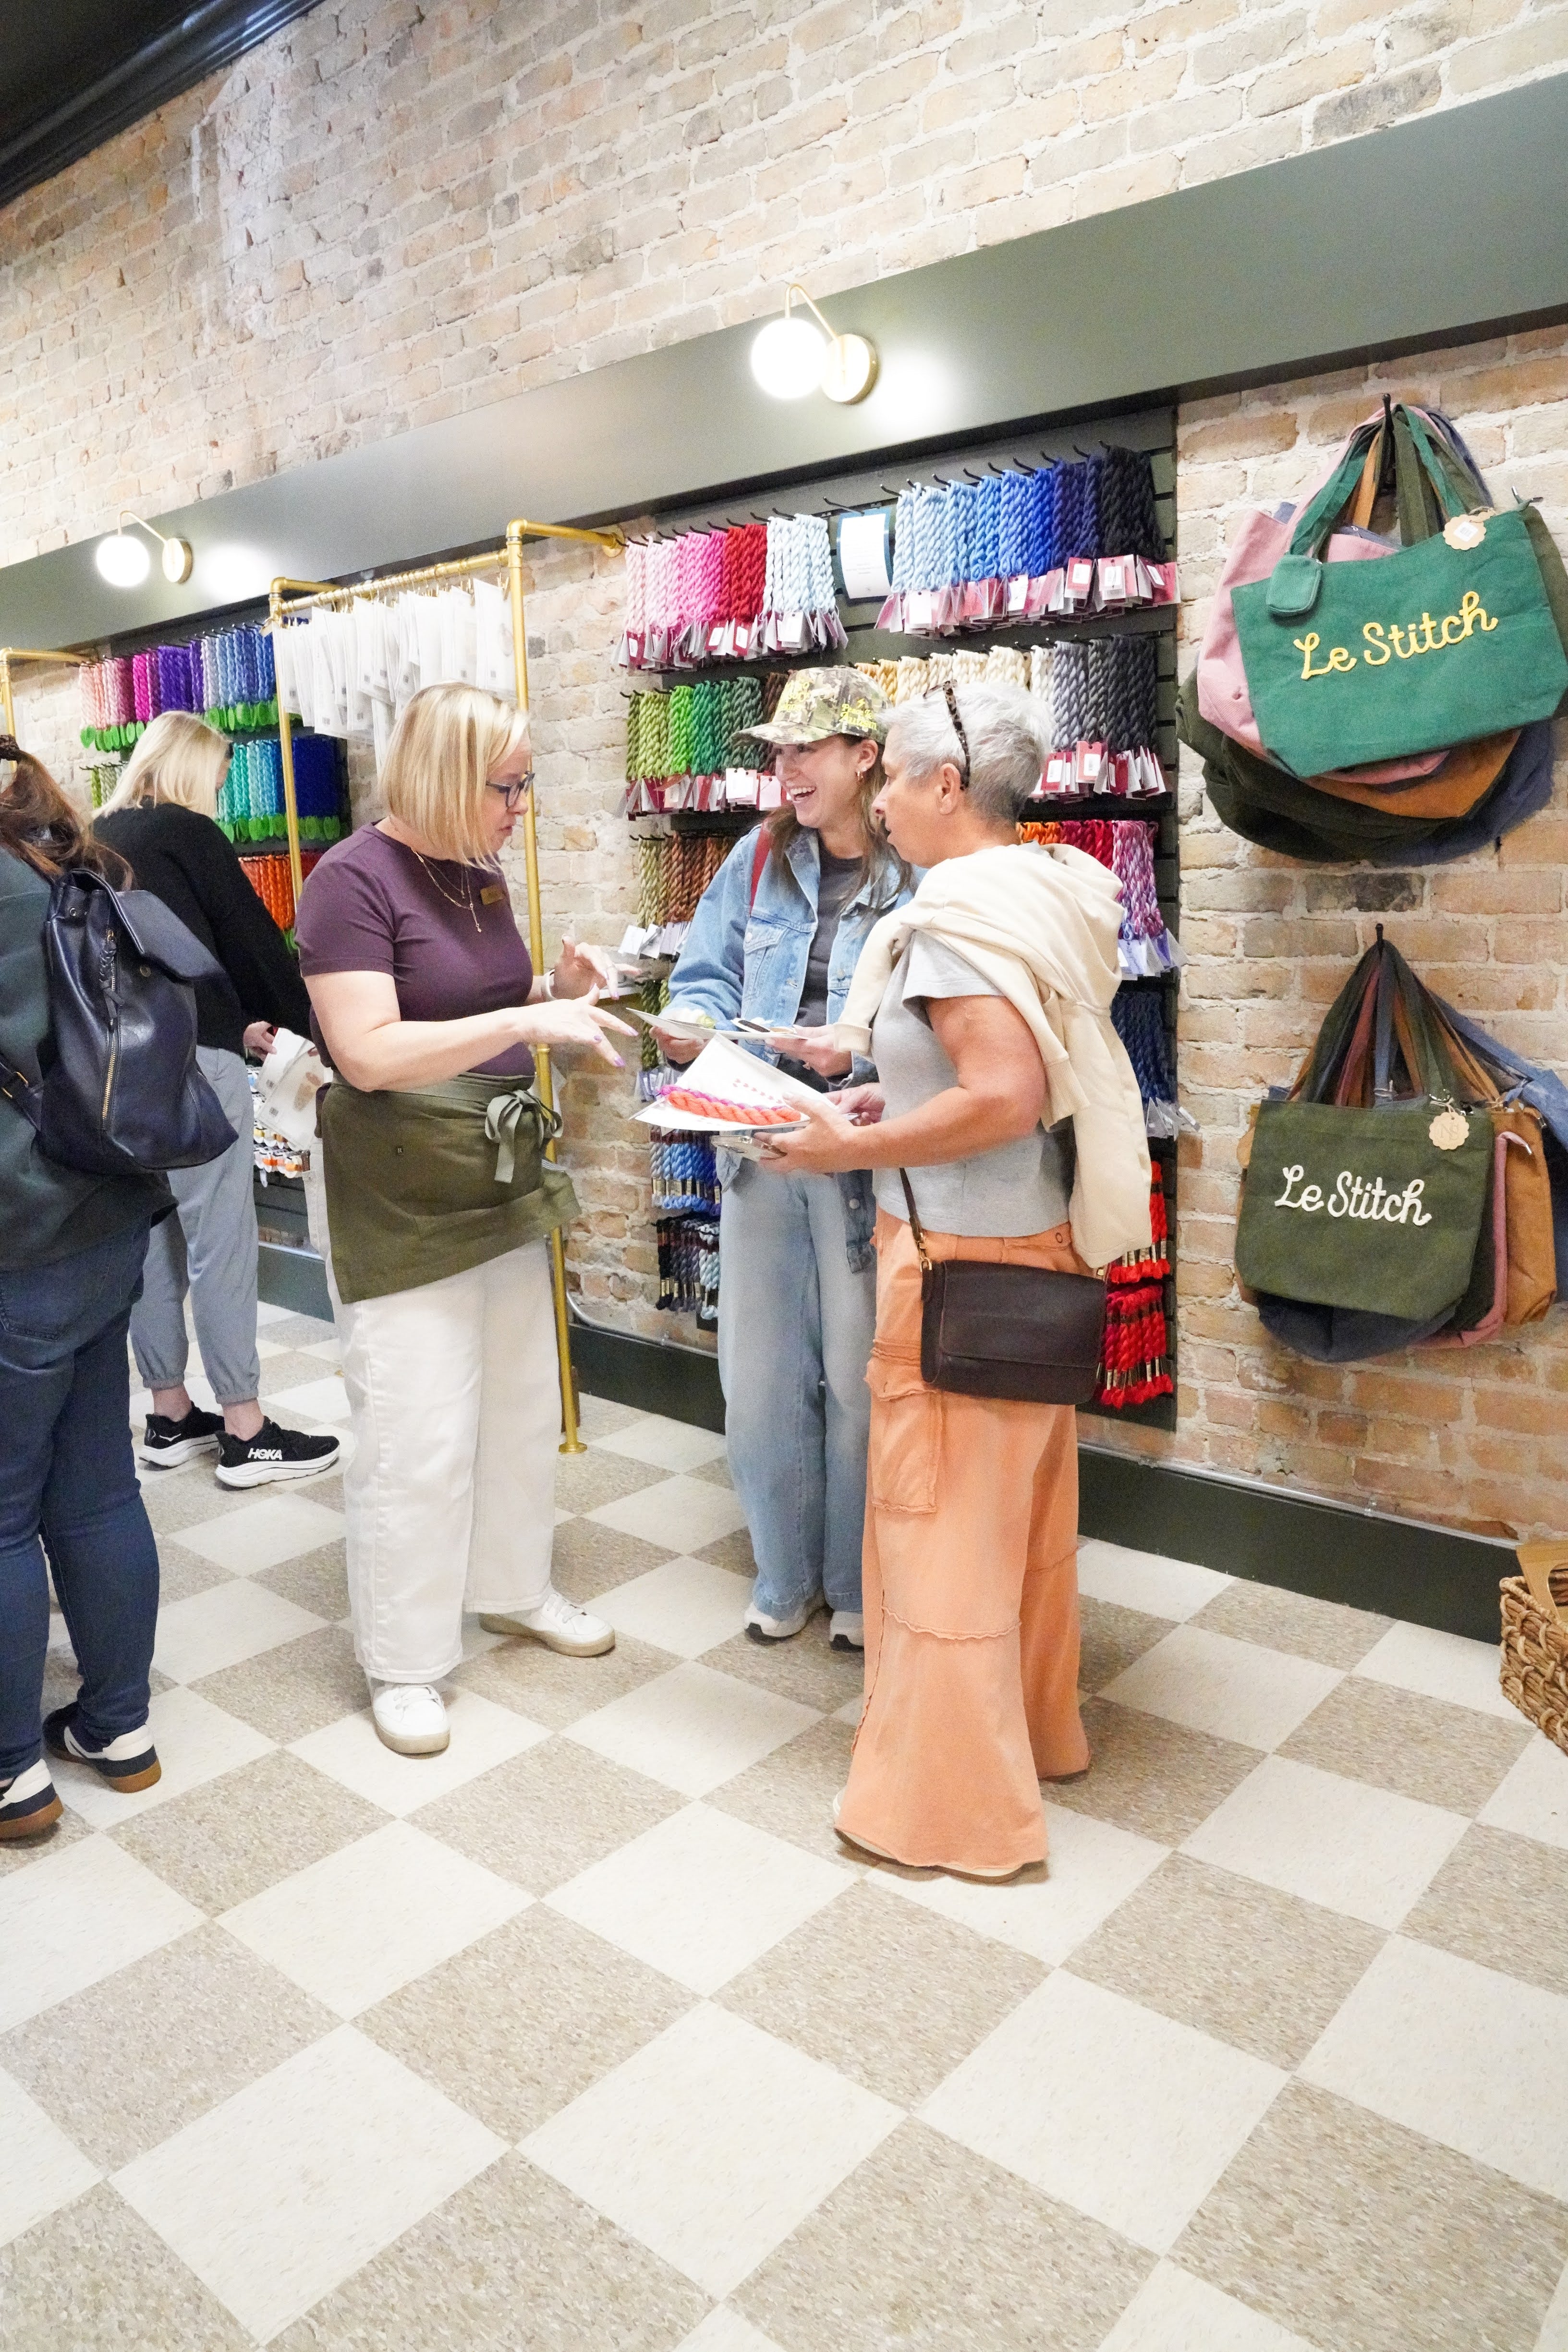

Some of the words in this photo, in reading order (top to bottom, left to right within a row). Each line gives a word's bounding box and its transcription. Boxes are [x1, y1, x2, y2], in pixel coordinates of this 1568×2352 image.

[1293, 632, 1357, 680] Le
[1362, 591, 1499, 666] Stitch
[1274, 1164, 1325, 1212] Le
[1327, 1171, 1433, 1226] Stitch
[247, 1448, 282, 1460] HOKA
